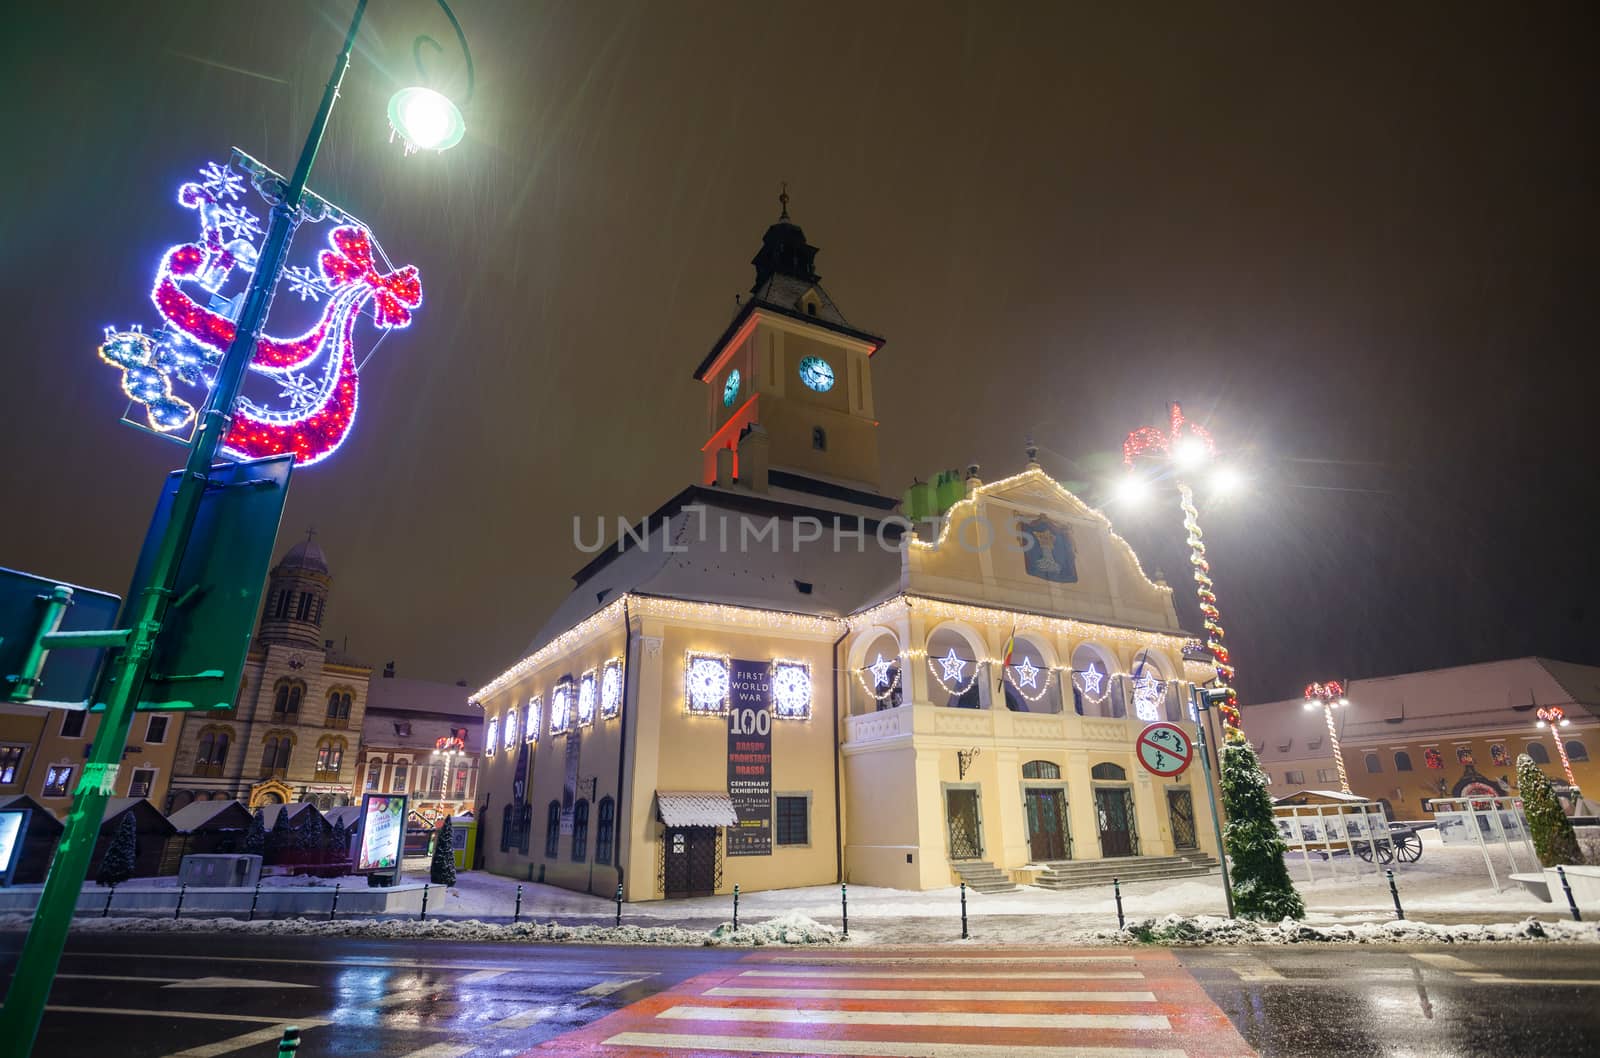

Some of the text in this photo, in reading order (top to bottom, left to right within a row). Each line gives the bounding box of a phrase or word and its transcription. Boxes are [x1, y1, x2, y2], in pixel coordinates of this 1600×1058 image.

[737, 671, 763, 680] FIRST
[732, 682, 769, 691] WORLD
[739, 693, 761, 701] WAR
[730, 708, 771, 735] 100
